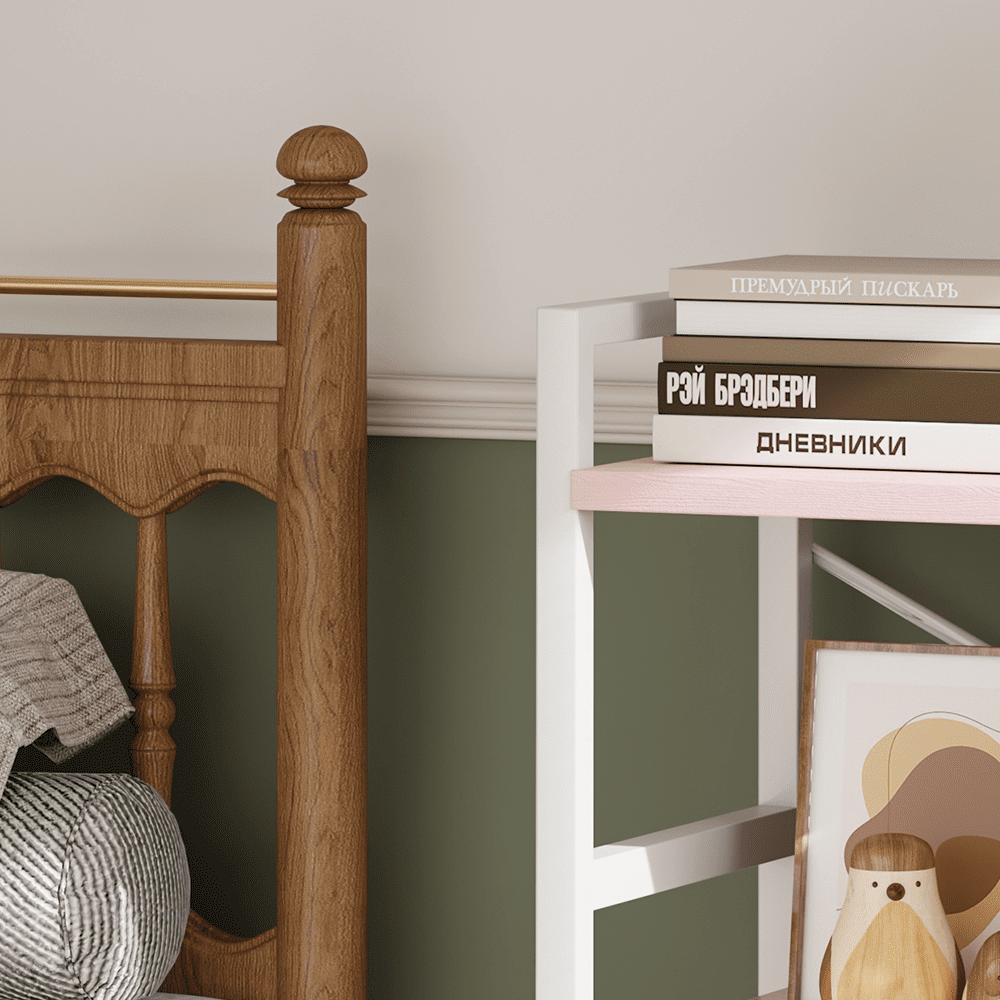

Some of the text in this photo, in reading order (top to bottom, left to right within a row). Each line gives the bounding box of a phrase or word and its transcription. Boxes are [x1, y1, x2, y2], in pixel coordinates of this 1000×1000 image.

[730, 276, 852, 297] ПРЕМУДРЫЙ
[666, 365, 817, 409] РЭЙ БРЭДБЕРИ
[756, 431, 907, 456] ДНЕВНИКИ
